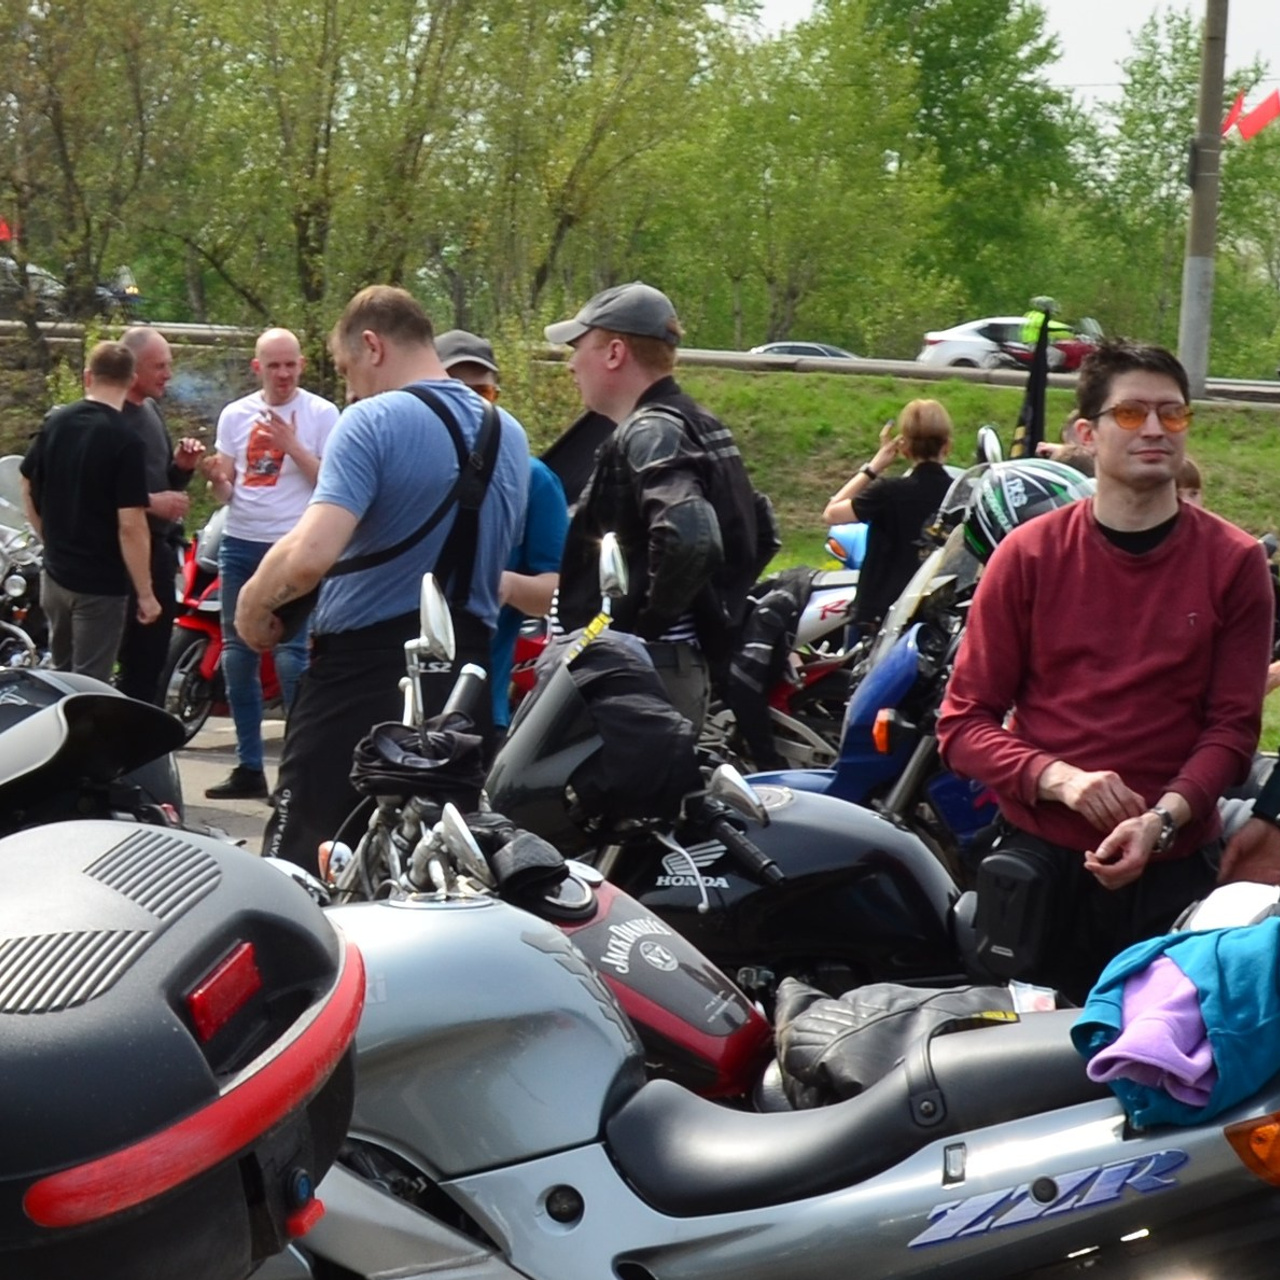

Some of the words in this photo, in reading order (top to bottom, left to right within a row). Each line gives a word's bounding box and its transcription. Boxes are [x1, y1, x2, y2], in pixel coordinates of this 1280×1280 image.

[278, 788, 293, 832] AHEAD
[655, 875, 730, 889] HONDA
[600, 933, 630, 974] JACK
[907, 1148, 1189, 1248] ZZR
